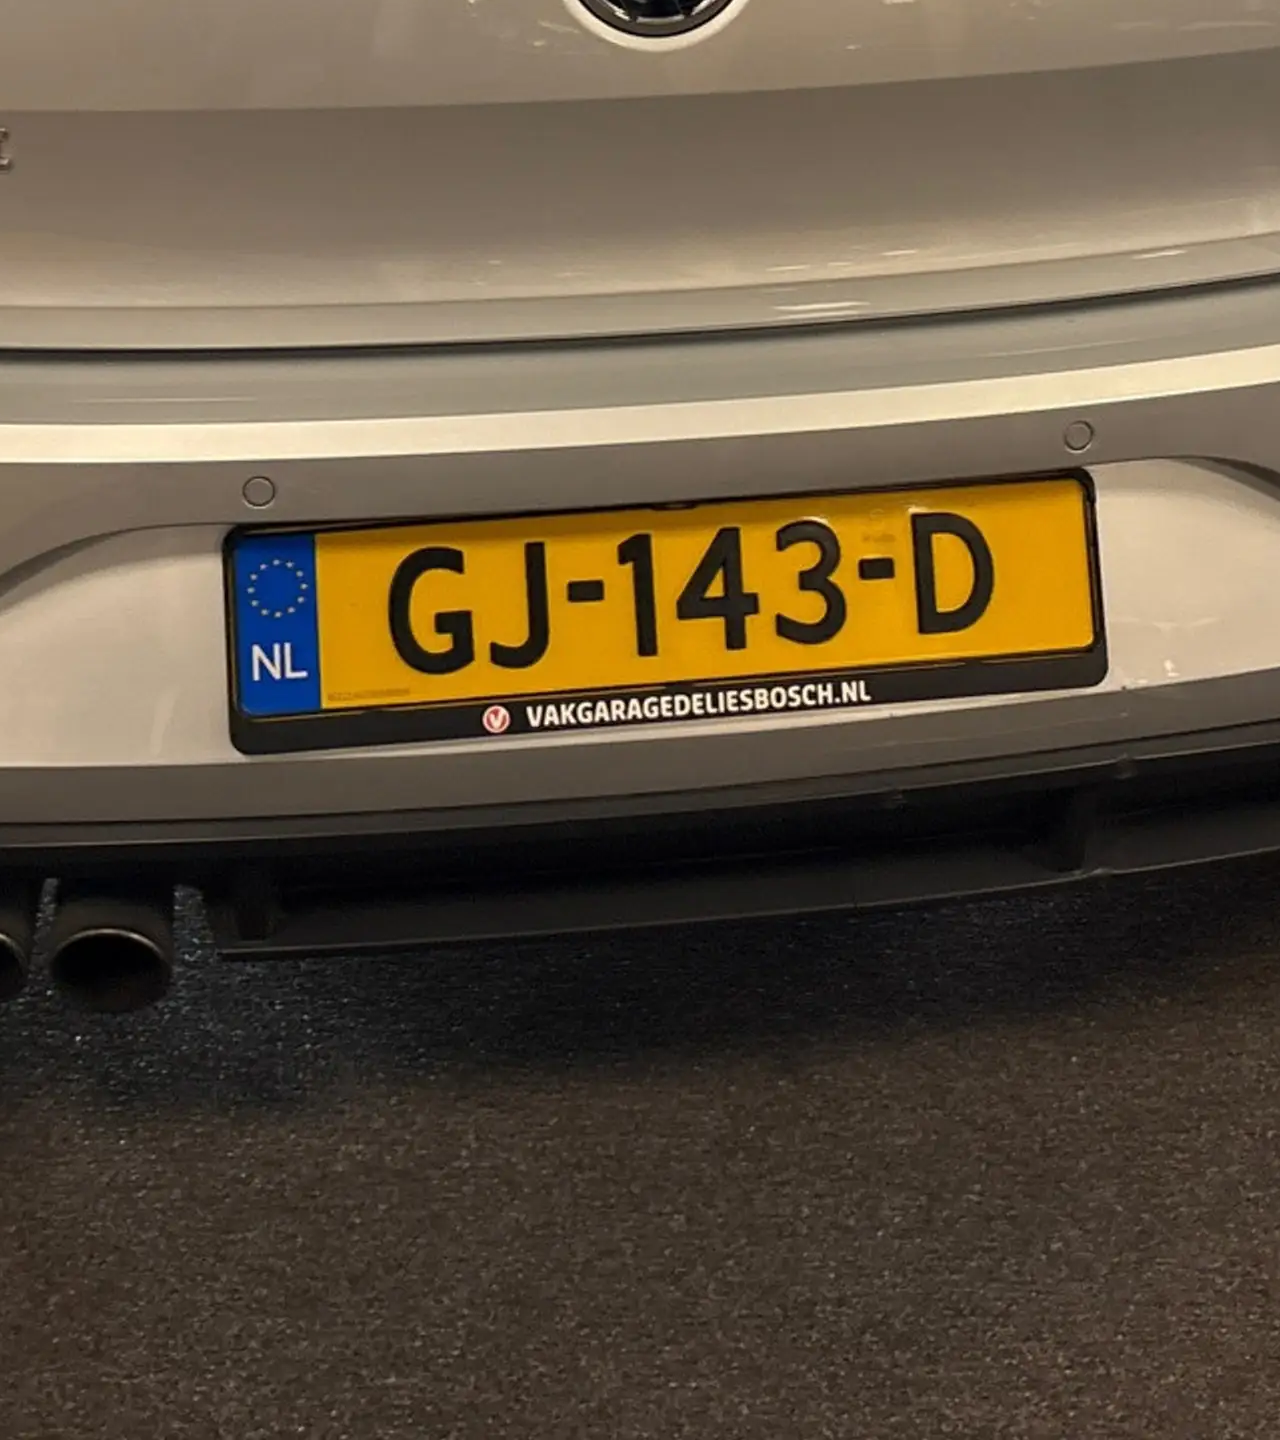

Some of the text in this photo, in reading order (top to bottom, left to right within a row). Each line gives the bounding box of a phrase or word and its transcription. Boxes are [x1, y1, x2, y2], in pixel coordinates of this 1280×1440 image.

[387, 512, 996, 675] GJ-143-D
[250, 643, 308, 682] NL
[526, 679, 871, 728] VAKGARAGEDELIESBOSCH.NL
